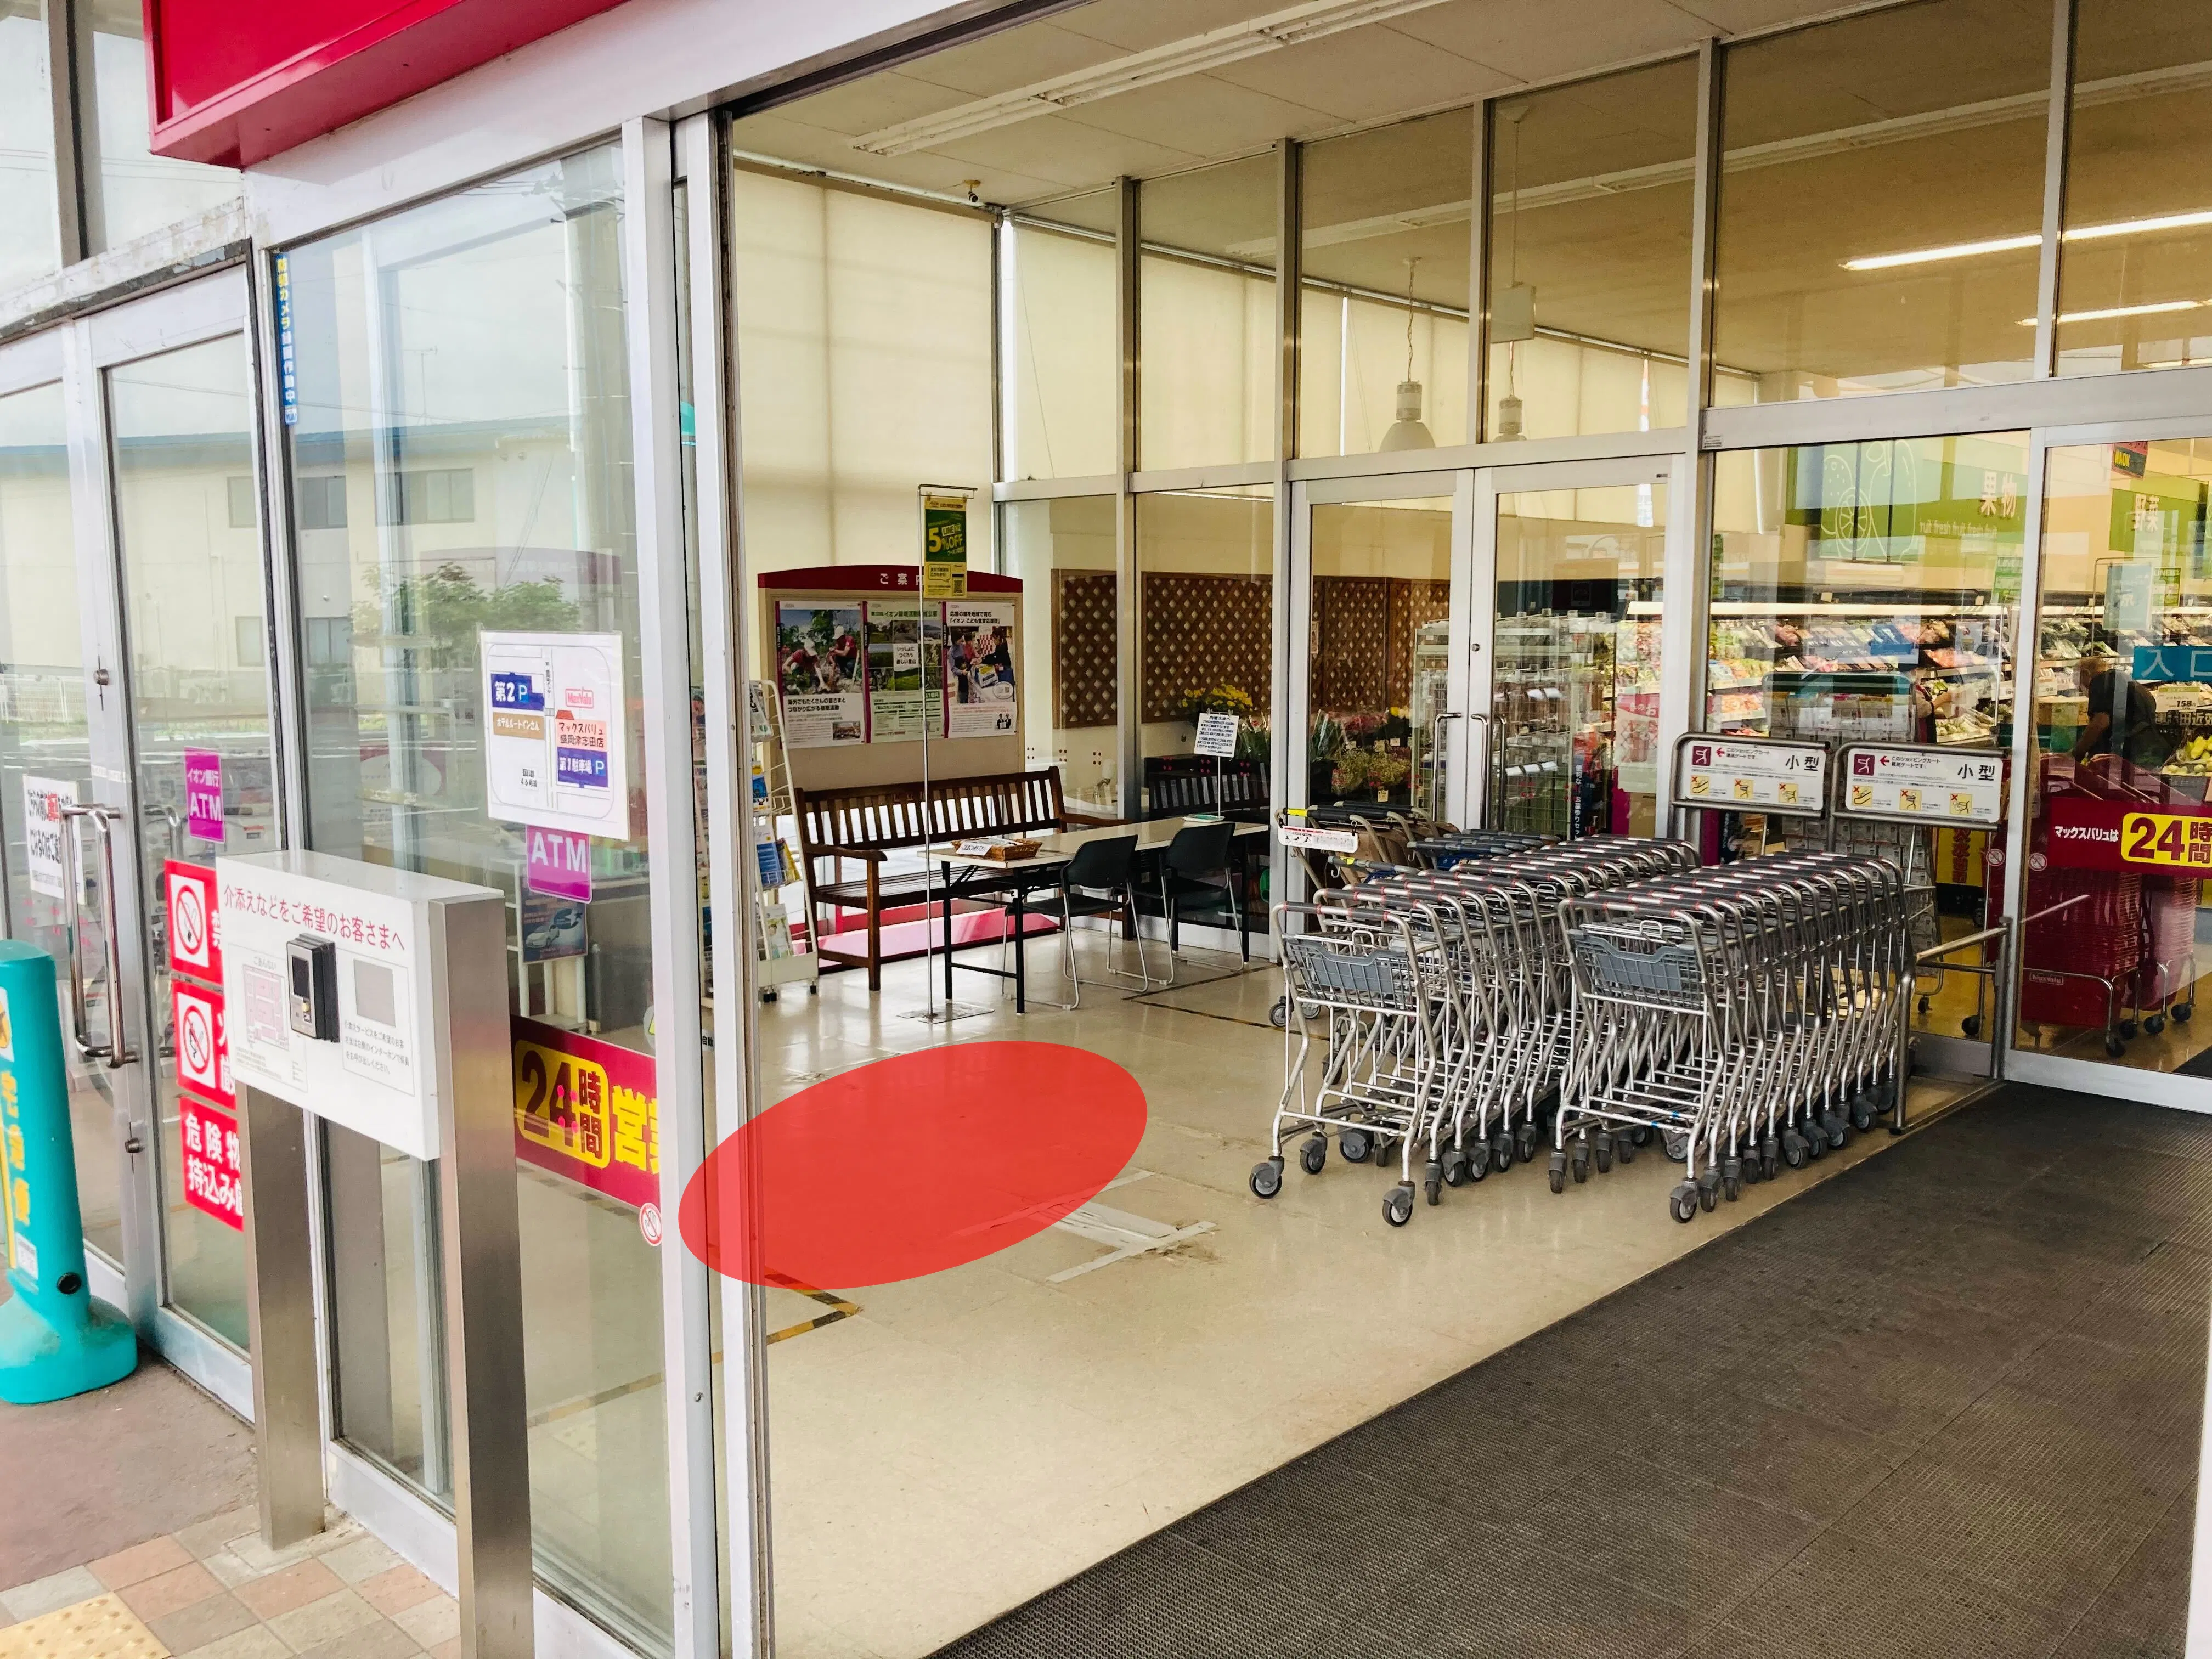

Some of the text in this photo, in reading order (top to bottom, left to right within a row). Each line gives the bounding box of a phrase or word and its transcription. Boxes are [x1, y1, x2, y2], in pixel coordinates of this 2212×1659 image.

[1980, 470, 2017, 518] 果物
[2133, 494, 2159, 532] 野菜
[496, 716, 540, 731] ホテルルートインさん
[558, 721, 603, 735] マックスバリュ
[560, 735, 604, 748] 盛岡津志田店
[1786, 755, 1819, 771] 小型
[1957, 764, 1995, 781] 小型
[187, 768, 219, 787] イオン銀行
[190, 792, 222, 821] ATM
[2055, 826, 2119, 843] マックスバリュは
[531, 832, 586, 873] ATM
[224, 883, 405, 951] 介添えなどをご希望のお客さまへ
[185, 1113, 241, 1172] 危険物
